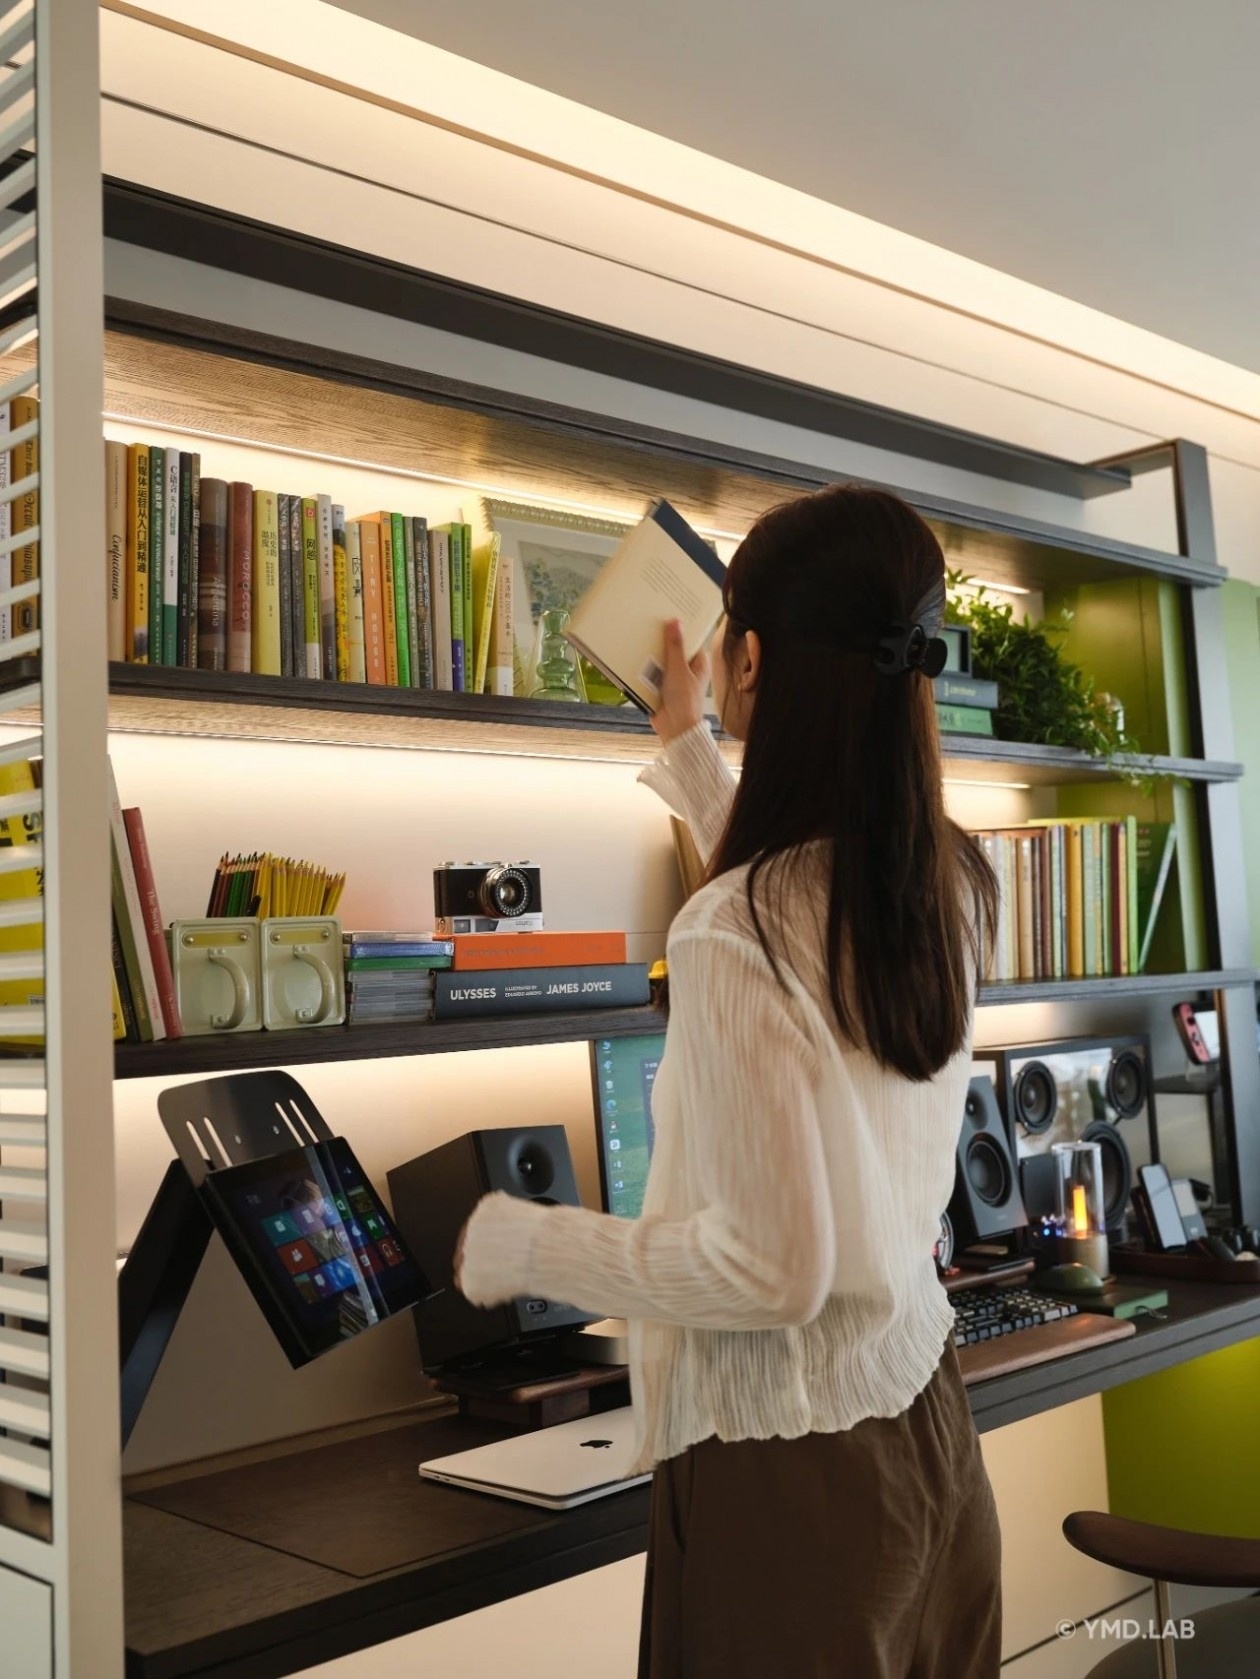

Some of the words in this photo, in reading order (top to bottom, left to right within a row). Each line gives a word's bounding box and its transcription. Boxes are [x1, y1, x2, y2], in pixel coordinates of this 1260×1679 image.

[137, 455, 147, 573] 自媒体运营从入门到精通
[107, 533, 121, 601] Confucianism
[242, 550, 250, 620] MOROCCO
[150, 907, 161, 936] Swing
[450, 987, 497, 1000] ULYSSES
[546, 983, 579, 995] JAMES
[581, 981, 612, 992] JOYCE
